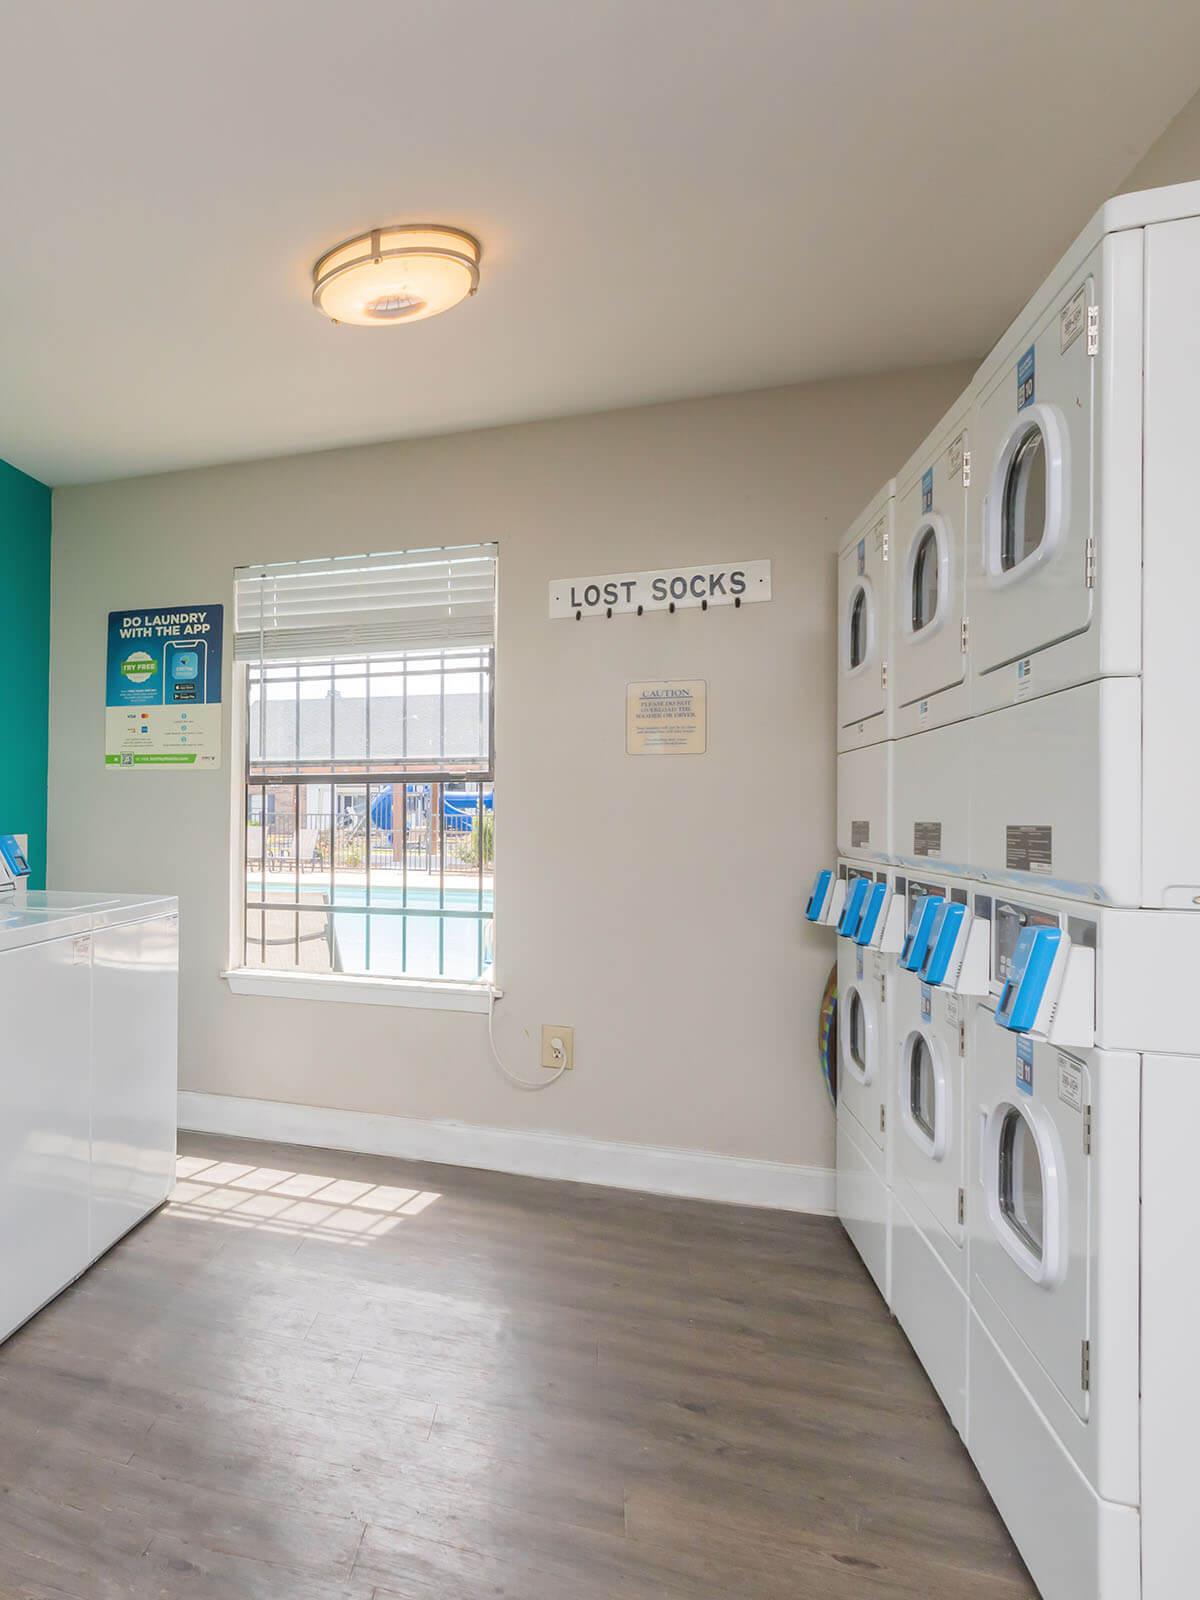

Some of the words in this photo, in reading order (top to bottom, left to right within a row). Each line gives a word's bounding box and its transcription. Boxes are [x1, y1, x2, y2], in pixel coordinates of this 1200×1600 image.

[571, 581, 637, 608] LOST
[652, 571, 746, 601] SOCKS
[123, 617, 142, 628] DO
[145, 612, 207, 626] LAUNDRY
[120, 628, 152, 639] WITH
[155, 625, 181, 637] THE
[184, 623, 211, 635] APP
[642, 689, 689, 697] CAUTION
